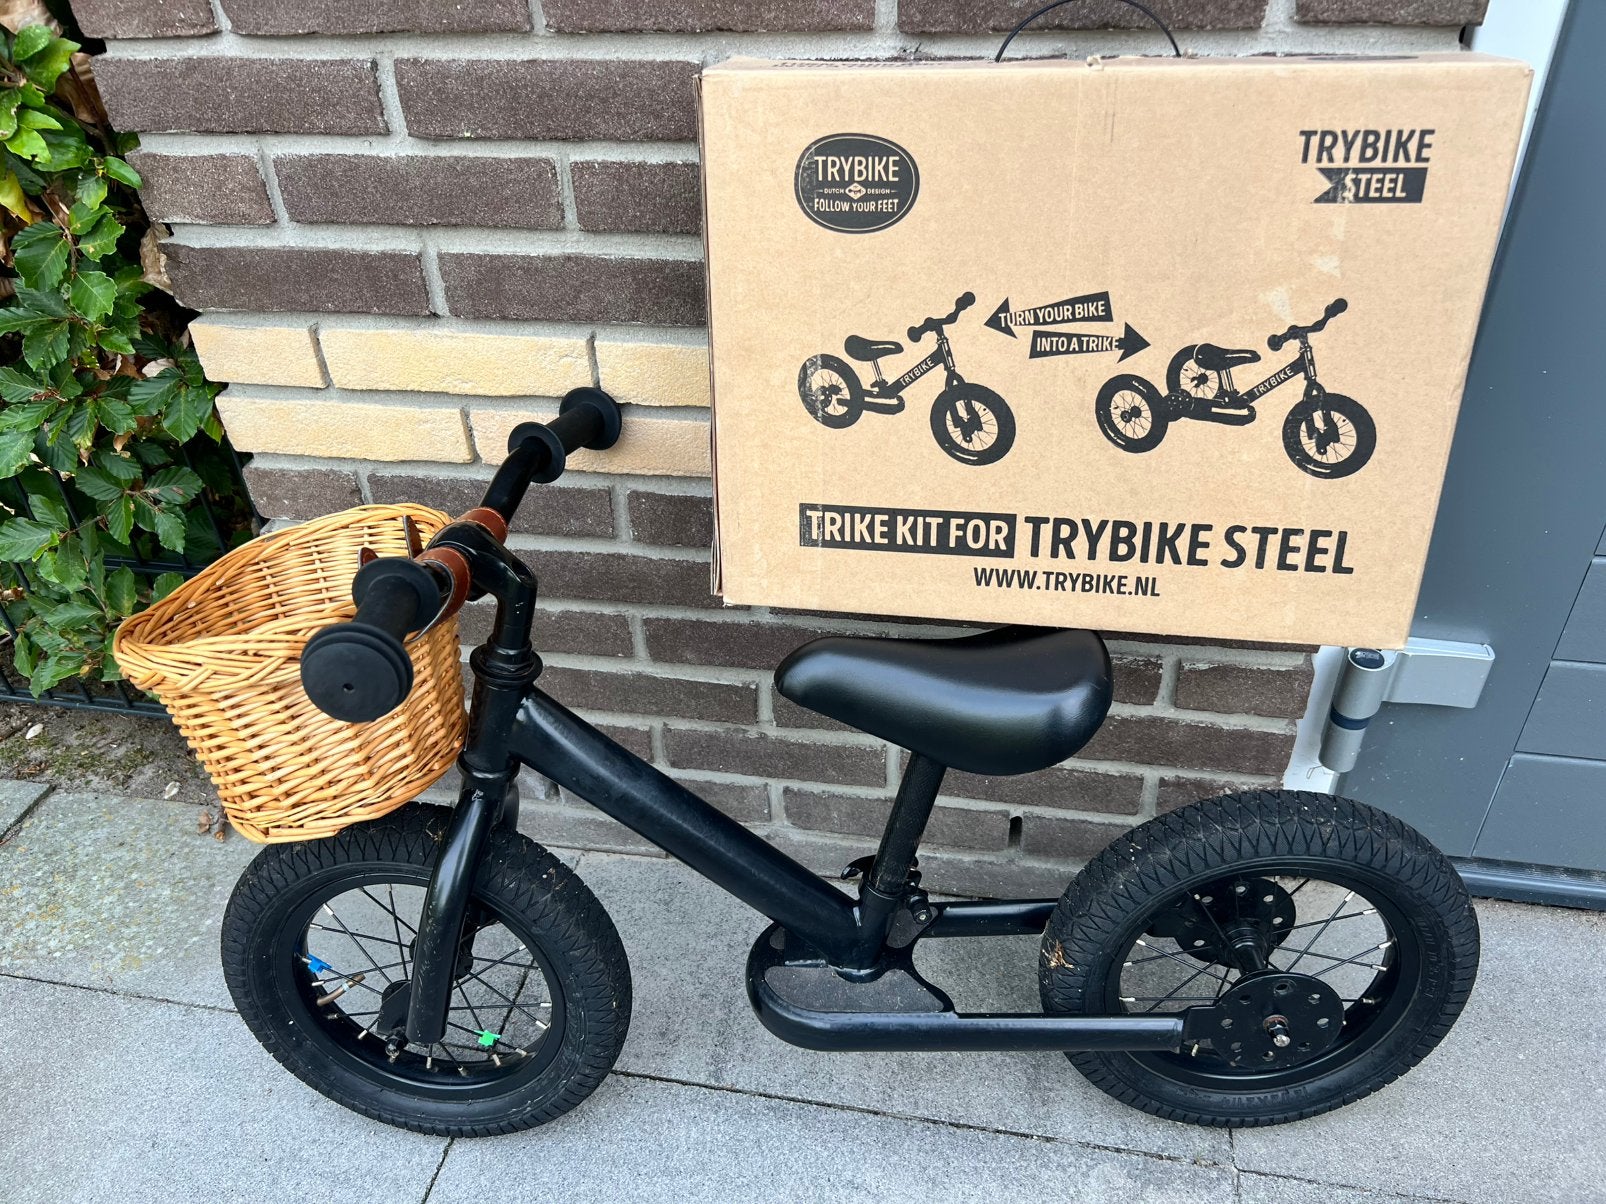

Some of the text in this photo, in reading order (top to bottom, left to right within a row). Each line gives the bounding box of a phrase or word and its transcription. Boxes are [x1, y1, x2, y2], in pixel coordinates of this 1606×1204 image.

[1299, 129, 1436, 164] TRYBIKE
[814, 156, 900, 182] TRYBIKE
[1342, 173, 1407, 198] STEEL
[814, 198, 899, 212] FOLLOW YOUR FEET
[999, 300, 1106, 328] TURN YOUR BIKE
[1036, 337, 1119, 352] INTO A TRIKE
[900, 357, 935, 386] TRYBIKE
[1253, 366, 1294, 396] TRYBIKE
[805, 510, 1354, 575] TRIKE KIT FOR TRYBIKE STEEL
[973, 567, 1161, 597] WWW.TRYBIKE.NL
